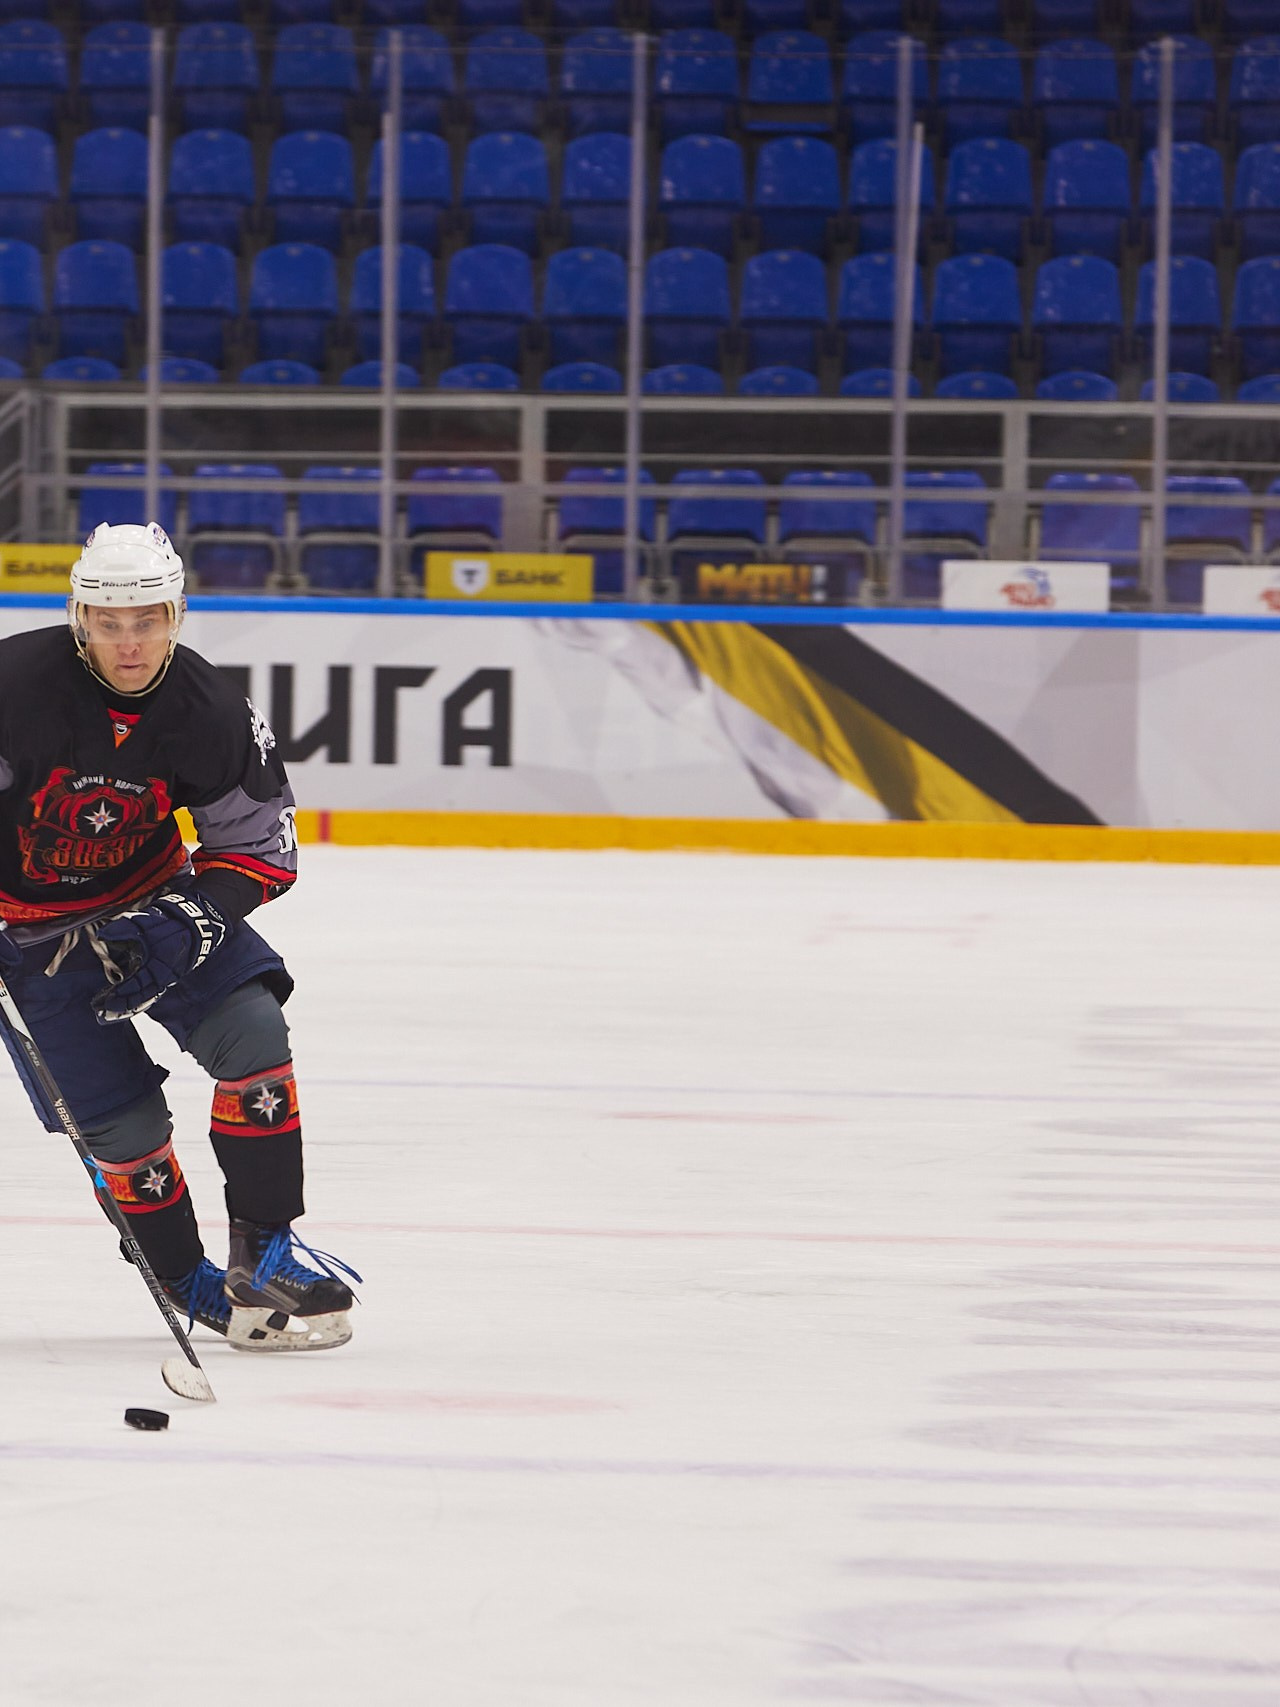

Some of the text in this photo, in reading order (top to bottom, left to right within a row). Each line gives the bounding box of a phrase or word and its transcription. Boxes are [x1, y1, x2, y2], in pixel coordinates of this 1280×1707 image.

[495, 569, 564, 587] БАНК
[158, 893, 213, 970] BAUER
[55, 1105, 81, 1142] BAUER
